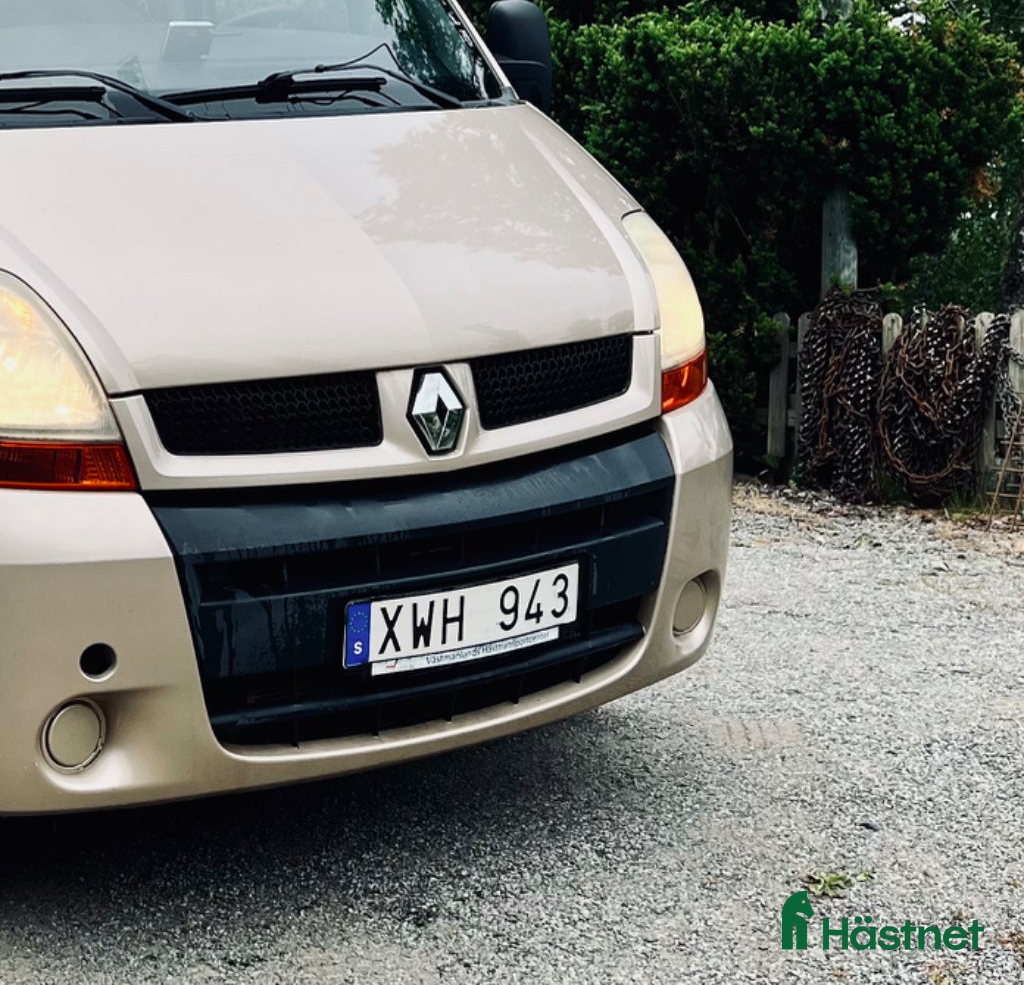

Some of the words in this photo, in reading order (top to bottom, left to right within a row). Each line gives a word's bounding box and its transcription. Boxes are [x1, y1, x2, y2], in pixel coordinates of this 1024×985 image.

[378, 595, 465, 655] XWH
[499, 573, 569, 632] 943
[353, 641, 363, 655] S
